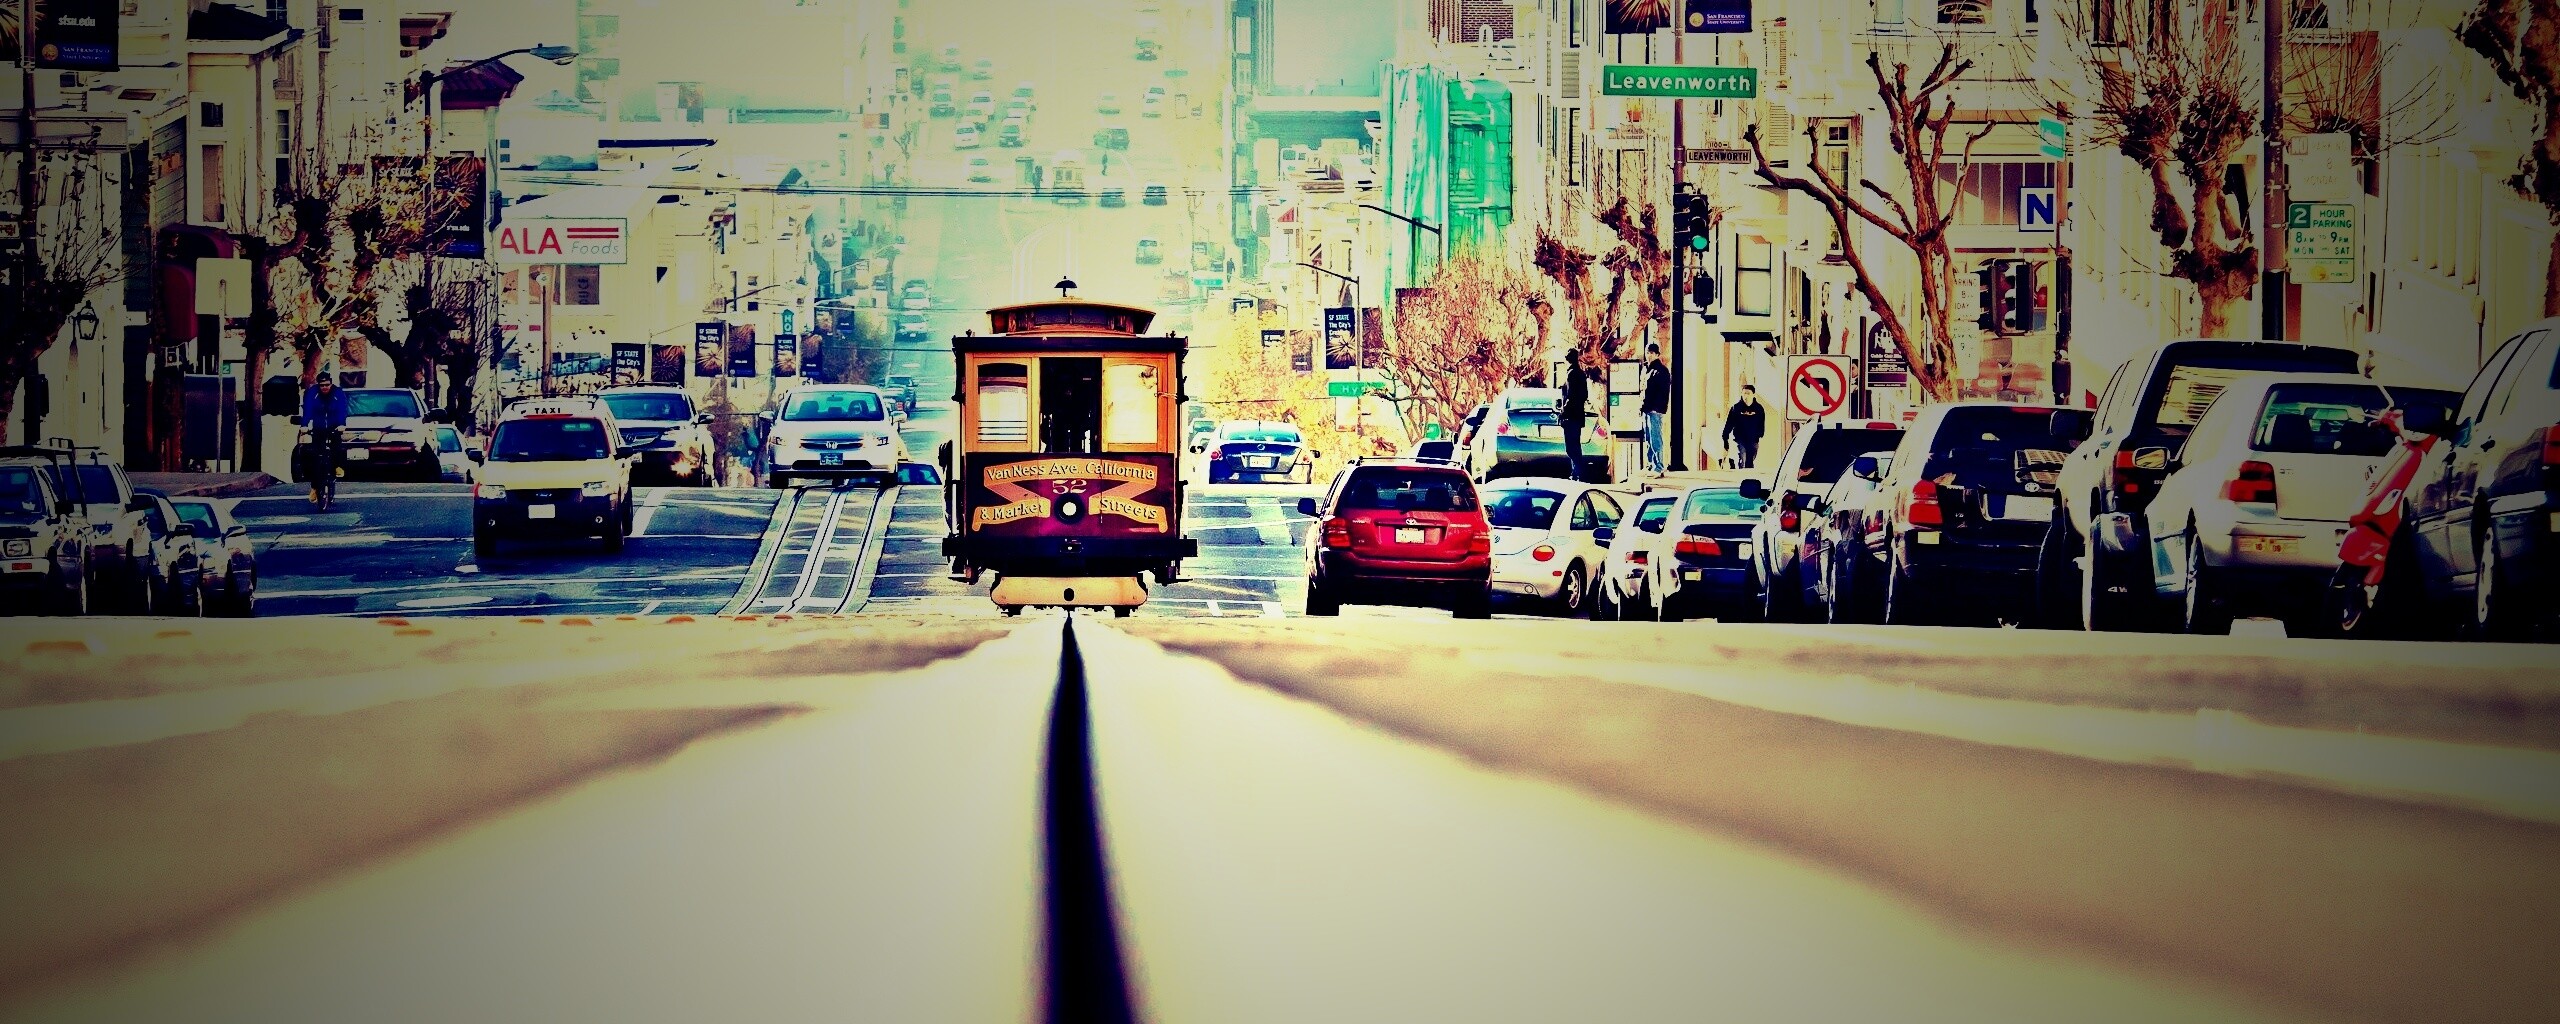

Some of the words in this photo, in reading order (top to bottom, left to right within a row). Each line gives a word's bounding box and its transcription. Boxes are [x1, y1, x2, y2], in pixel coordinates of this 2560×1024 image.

[1609, 72, 1751, 92] Leavenworth
[1688, 151, 1749, 162] LEAVENWORTH
[2294, 207, 2307, 224] 2
[2319, 209, 2345, 218] HOUR
[2312, 219, 2352, 229] PARKING
[570, 240, 620, 255] Foods
[1611, 398, 1618, 406] 2
[534, 407, 562, 415] TAXI
[1012, 463, 1045, 478] Ness
[1085, 461, 1156, 481] California
[1052, 479, 1088, 495] 52
[992, 502, 1044, 520] Market
[1100, 498, 1158, 520] Streets
